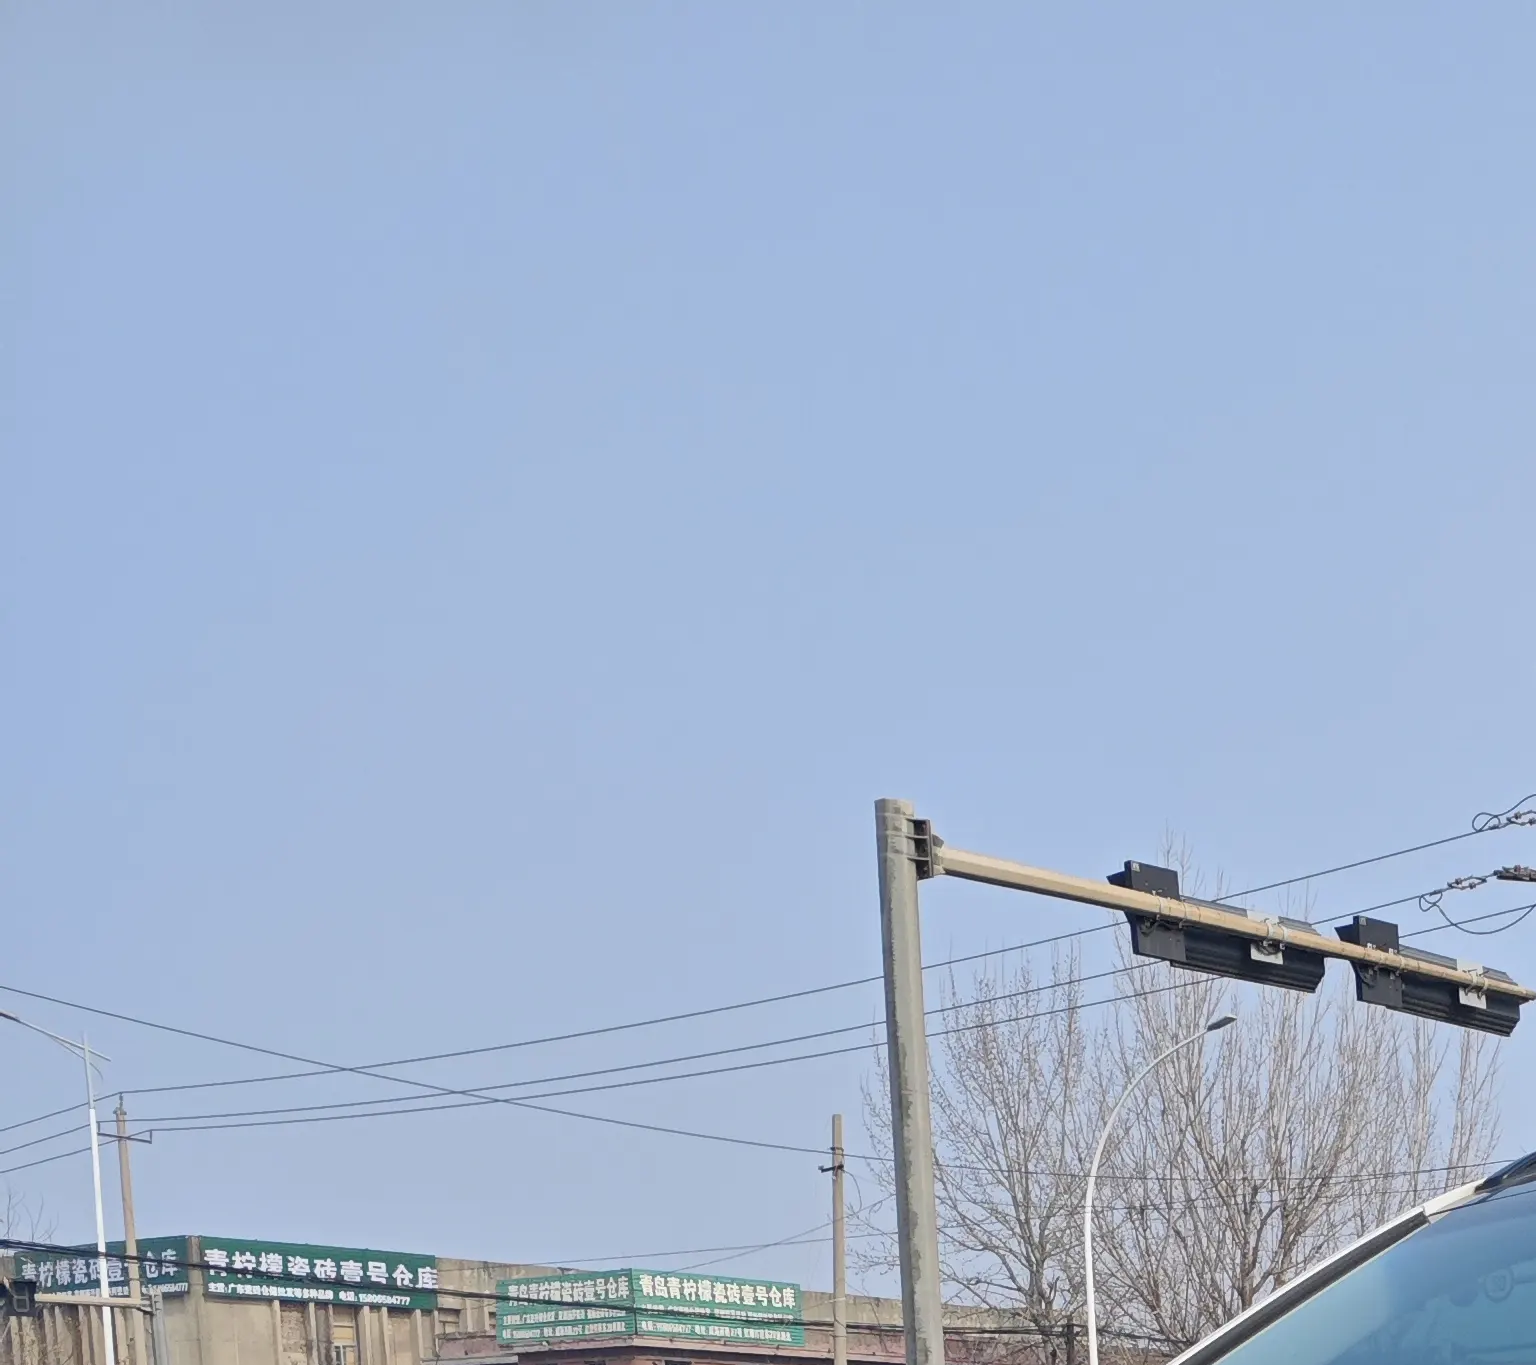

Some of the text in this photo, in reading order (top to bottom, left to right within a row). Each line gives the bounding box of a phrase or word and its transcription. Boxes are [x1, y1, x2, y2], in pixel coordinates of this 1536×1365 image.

[20, 1248, 180, 1288] 青柠檬瓷砖壹仓库
[204, 1249, 439, 1290] 青柠檬瓷砖壹号仓库
[639, 1274, 796, 1309] 青岛青柠檬瓷砖壹号仓库
